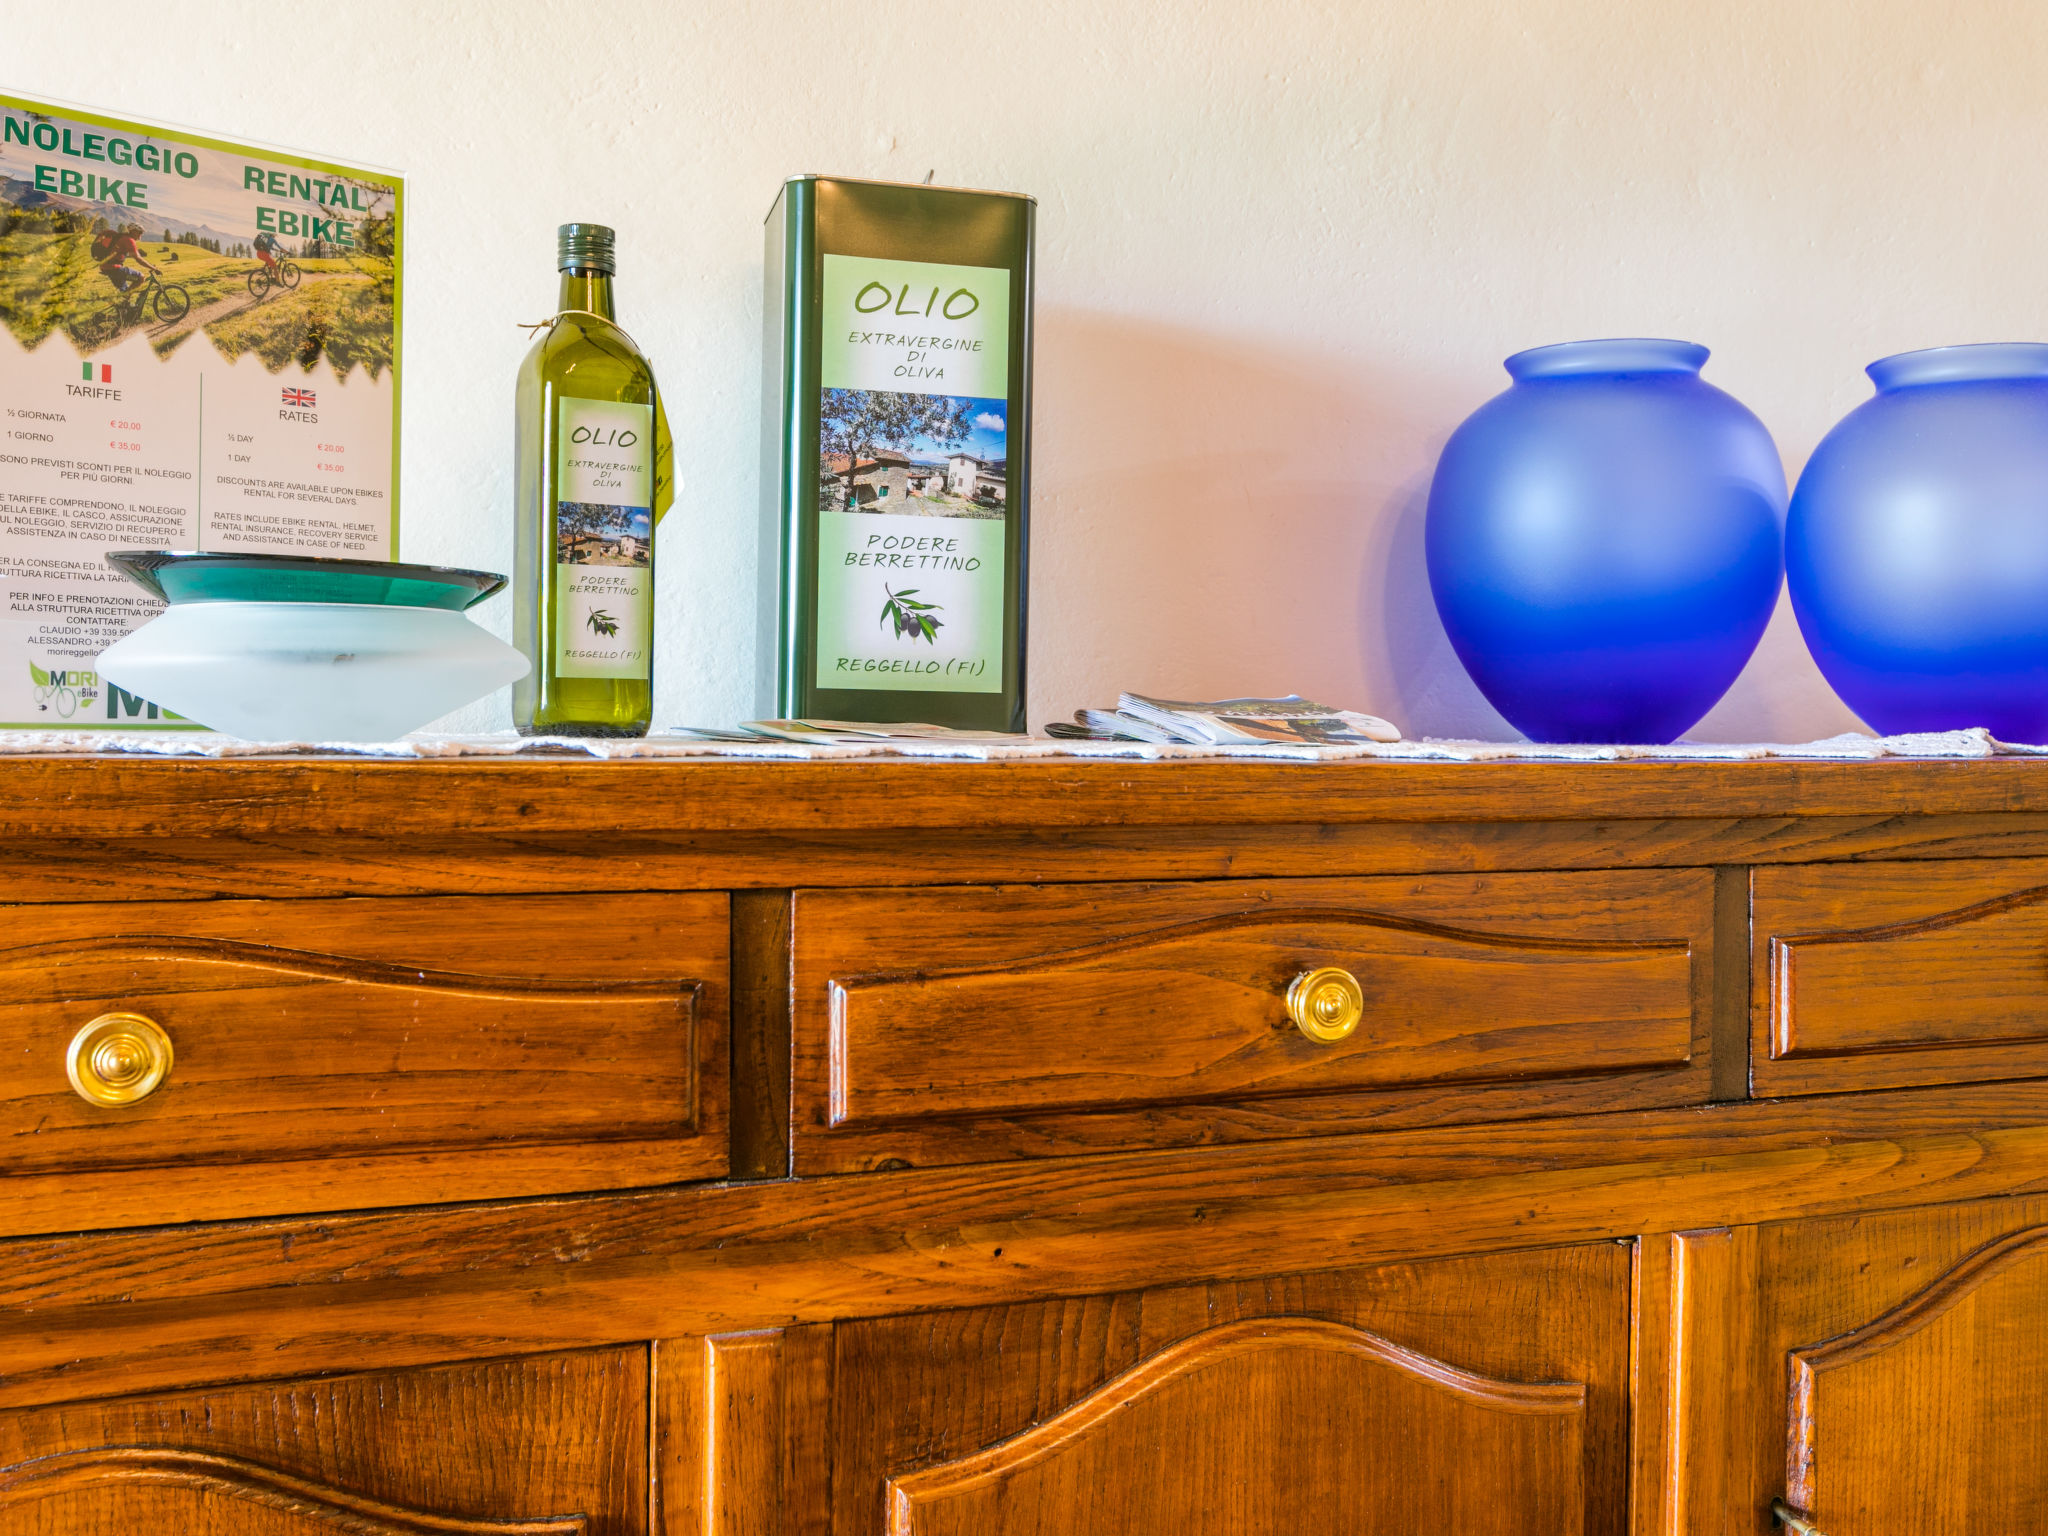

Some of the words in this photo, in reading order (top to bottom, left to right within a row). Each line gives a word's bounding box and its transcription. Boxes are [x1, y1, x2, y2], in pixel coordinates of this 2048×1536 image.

[4, 116, 199, 179] NOLEGGIO
[33, 164, 149, 209] EBIKE
[243, 165, 368, 212] RENTAL
[256, 206, 356, 247] EBIKE
[855, 281, 979, 320] OLIO
[848, 331, 984, 352] EXTRAVERGINE
[907, 351, 926, 362] DI
[894, 365, 944, 379] OLIVA
[66, 384, 122, 401] TARIFFE
[17, 410, 66, 422] GIORNATA
[279, 409, 318, 424] RATES
[110, 420, 116, 428] €
[15, 432, 54, 442] GIORNO
[237, 435, 253, 443] DAY
[571, 426, 638, 447] OLIO
[110, 441, 116, 449] €
[317, 443, 323, 451] €
[234, 455, 251, 463] DAY
[567, 459, 644, 473] EXTRAVERGINE
[0, 454, 28, 464] SONO
[31, 457, 74, 468] PREVISTI
[77, 462, 112, 472] SCONTI
[114, 465, 132, 474] PER
[135, 467, 142, 475] IL
[144, 468, 192, 480] NOLEGGIO
[60, 470, 79, 480] PER
[82, 471, 98, 481] PIÙ
[217, 476, 266, 488] DISCOUNTS
[268, 480, 285, 489] ARE
[286, 482, 329, 493] AVAILABLE
[330, 487, 353, 496] UPON
[355, 489, 383, 498] EBIKES
[592, 479, 622, 488] OLIVA
[244, 489, 276, 499] RENTAL
[278, 491, 295, 500] FOR
[297, 493, 333, 504] SEVERAL
[8, 494, 47, 504] TARIFFE
[129, 504, 137, 512] IL
[139, 505, 186, 516] NOLEGGIO
[62, 509, 71, 517] IL
[110, 513, 183, 526] ASSICURAZIONE
[214, 511, 242, 521] RATES
[244, 514, 280, 524] INCLUDE
[282, 517, 306, 527] EBIKE
[6, 526, 67, 538] ASSISTENZA
[79, 531, 107, 541] CASO
[108, 534, 118, 542] DI
[70, 520, 113, 531] SERVIZIO
[115, 524, 125, 532] DI
[127, 524, 177, 536] RECUPERO
[179, 528, 186, 536] E
[211, 522, 243, 532] RENTAL
[298, 528, 343, 539] RECOVERY
[344, 532, 378, 542] SERVICE
[222, 532, 242, 542] AND
[242, 534, 294, 546] ASSISTANCE
[296, 537, 305, 546] IN
[306, 538, 328, 548] CASE
[330, 540, 341, 549] OF
[867, 535, 959, 552] PODERE
[13, 558, 25, 566] LA
[26, 558, 81, 569] CONSEGNA
[83, 562, 96, 570] ED
[98, 562, 106, 571] IL
[844, 552, 980, 572] BERRETTINO
[44, 570, 92, 581] RICETTIVA
[94, 574, 106, 582] LA
[580, 576, 628, 586] PODERE
[568, 585, 639, 596] BERRETTINO
[9, 592, 30, 601] PER
[32, 593, 55, 602] INFO
[58, 594, 64, 602] E
[66, 594, 134, 606] PRENOTAZIONI
[10, 603, 35, 612] ALLA
[36, 604, 93, 614] STRUTTURA
[95, 607, 142, 617] RICETTIVA
[66, 617, 128, 627] CONTATTARE:
[39, 626, 82, 635] CLAUDIO
[83, 628, 100, 636] +39
[27, 636, 92, 646] ALESSANDRO
[94, 638, 110, 647] +39
[564, 649, 618, 659] REGGELLO
[836, 657, 940, 674] REGGELLO
[50, 671, 98, 686] MORI
[77, 687, 98, 698] eBike
